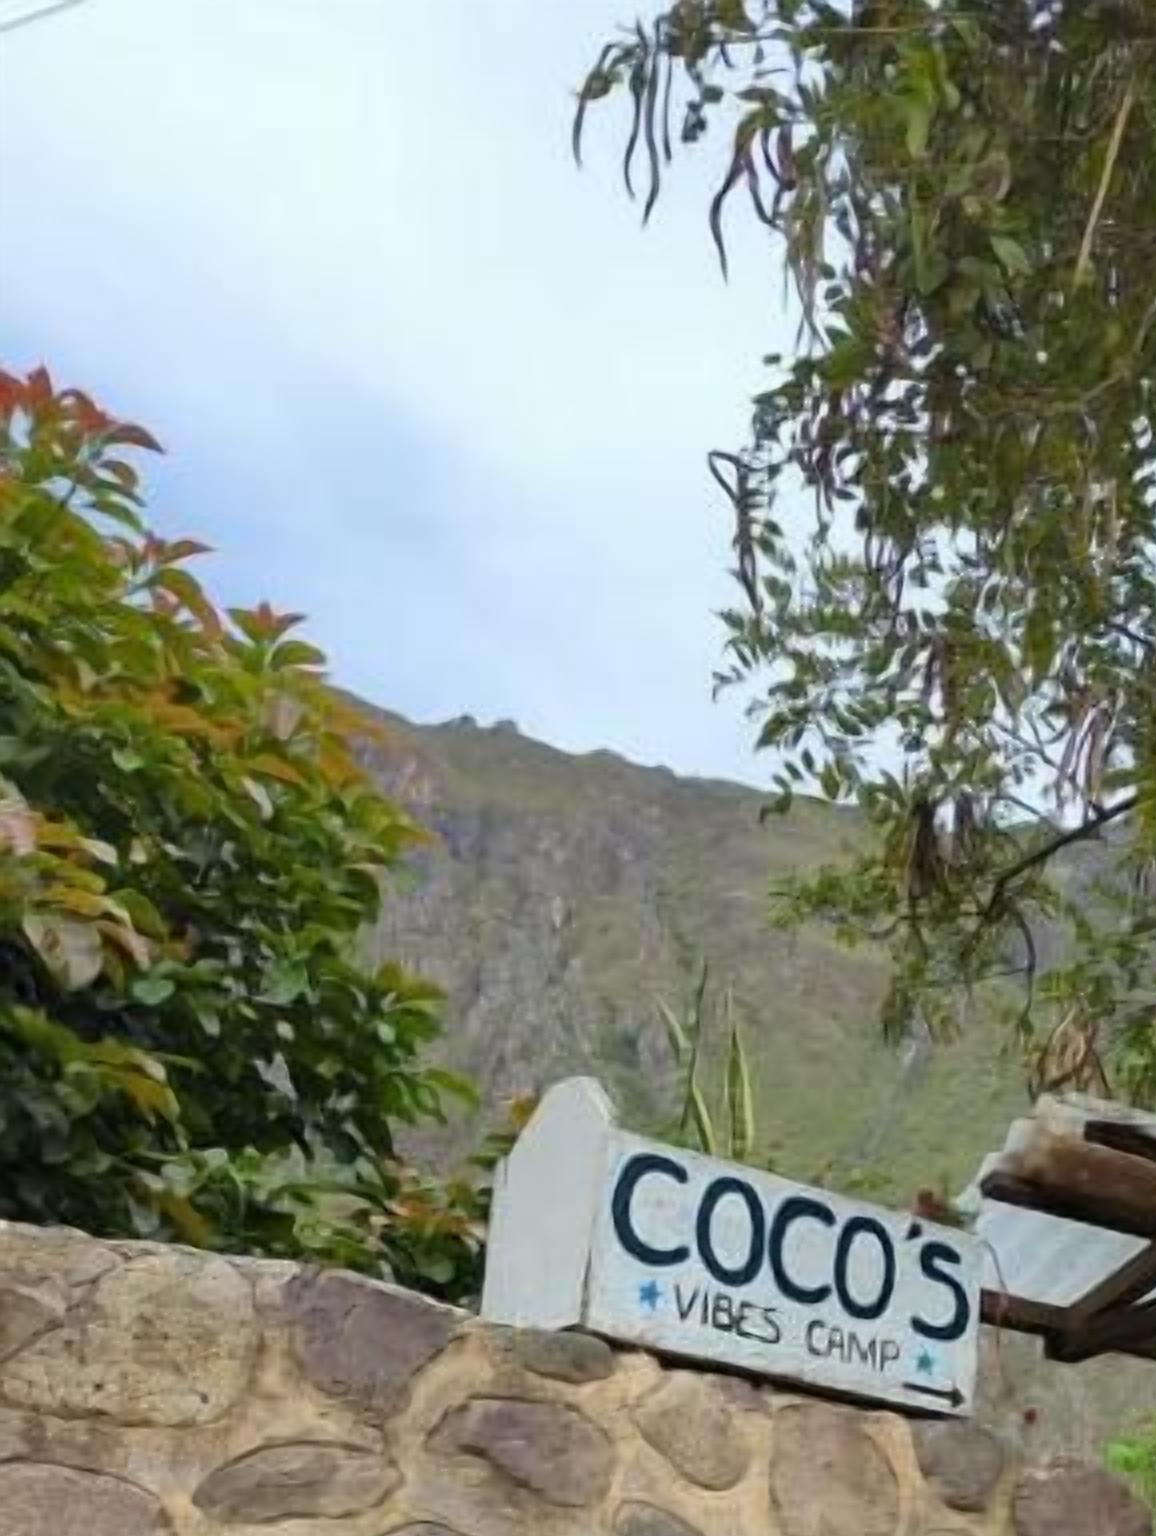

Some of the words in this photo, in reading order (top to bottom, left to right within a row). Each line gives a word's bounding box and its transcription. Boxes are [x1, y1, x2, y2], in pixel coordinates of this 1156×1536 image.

[611, 1153, 971, 1340] COCO'S
[673, 1283, 782, 1344] VIBES
[804, 1320, 900, 1372] CAMP
